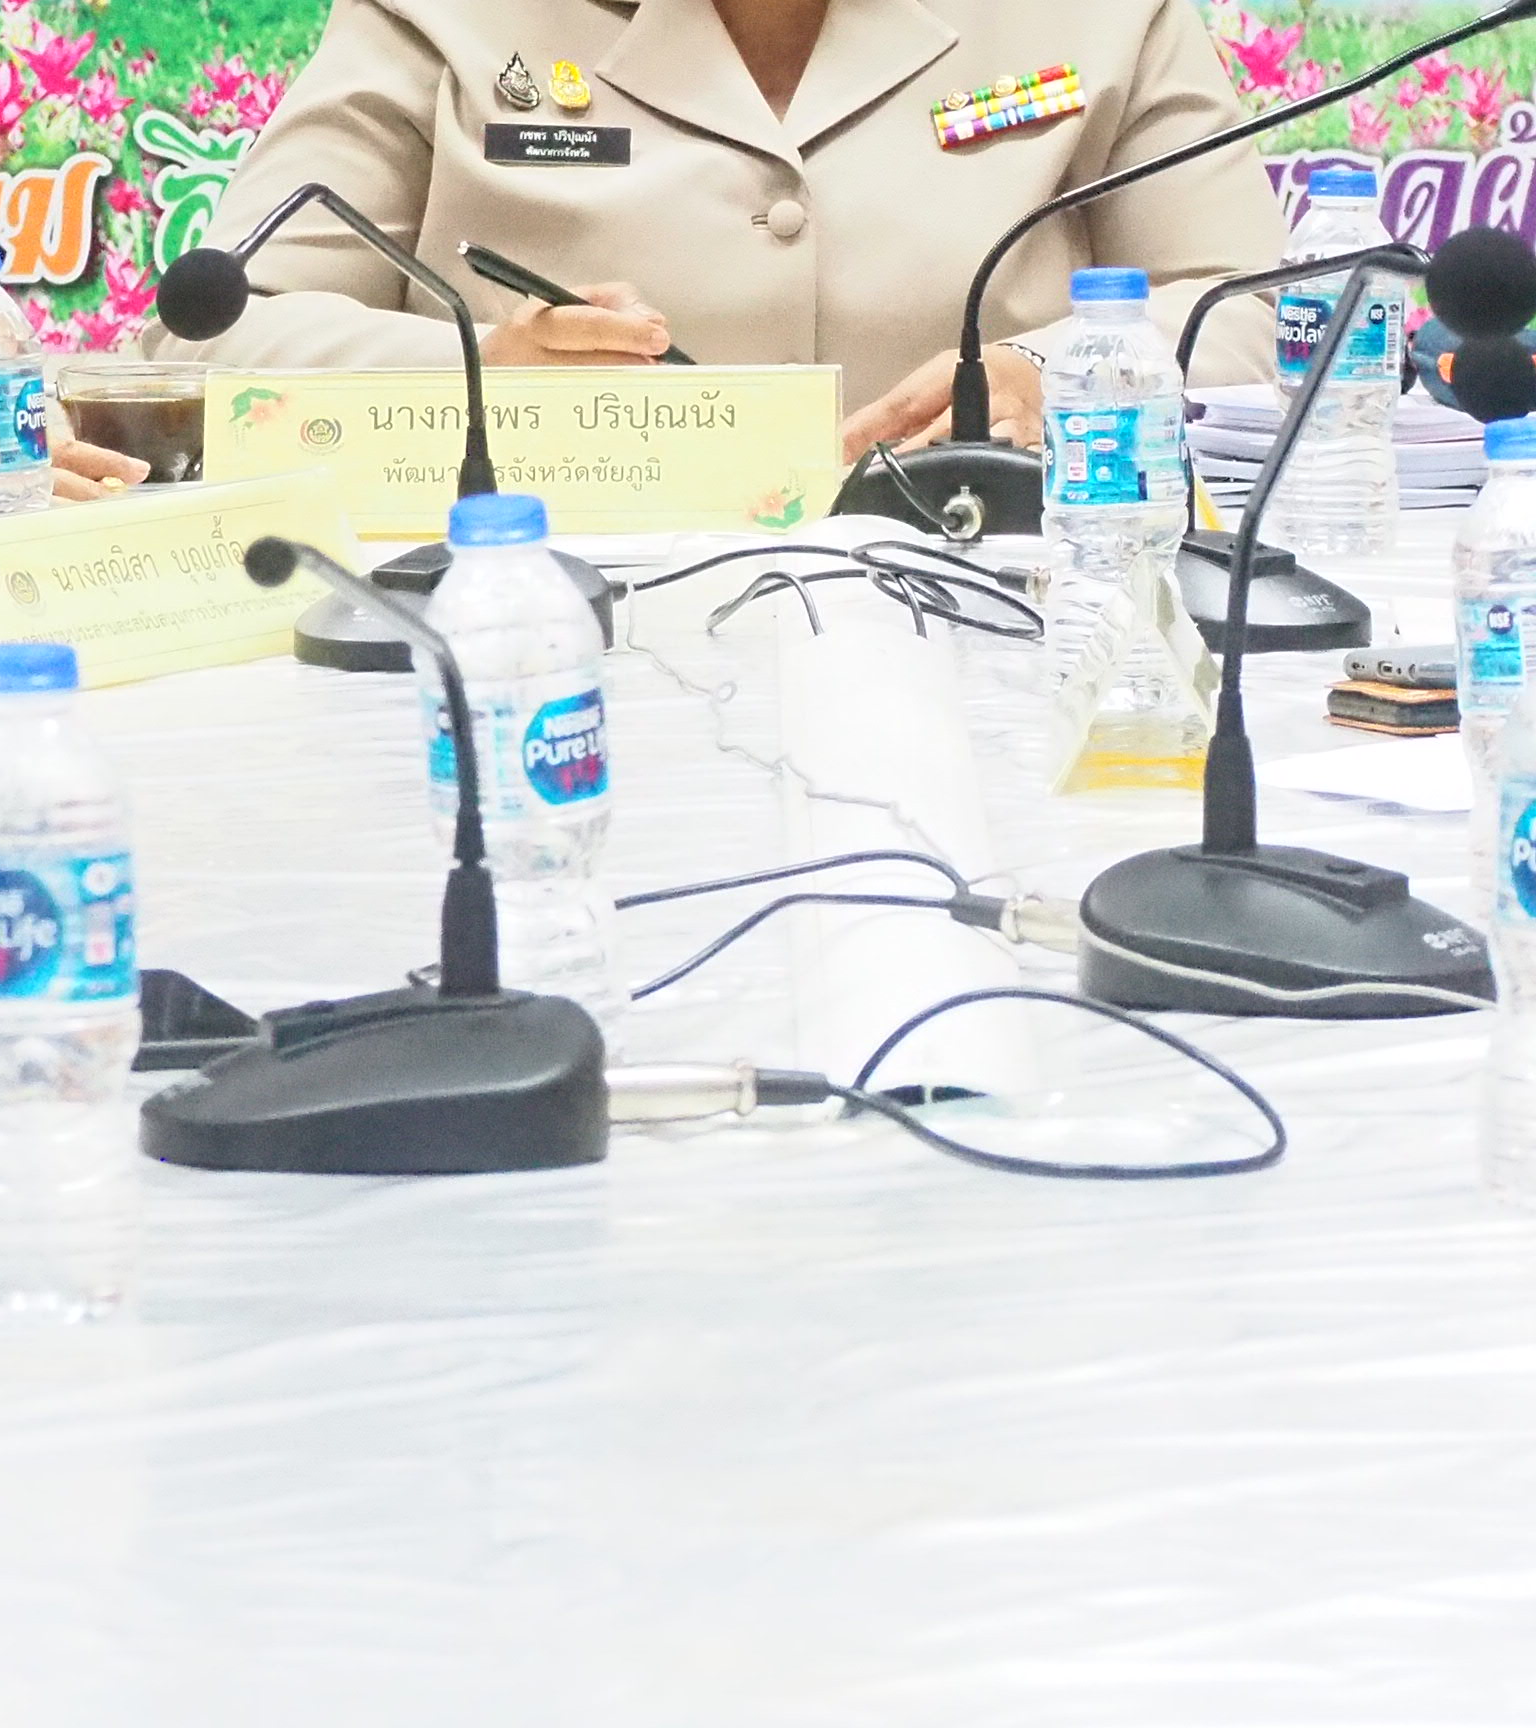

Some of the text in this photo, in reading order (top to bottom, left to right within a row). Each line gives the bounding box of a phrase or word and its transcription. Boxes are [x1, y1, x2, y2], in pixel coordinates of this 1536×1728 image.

[368, 389, 737, 442] นางกพร ปริปุณนัง
[383, 456, 662, 492] พัฒนารจังหวัดชัยภูมิ
[51, 544, 161, 597] นางสุณิสา
